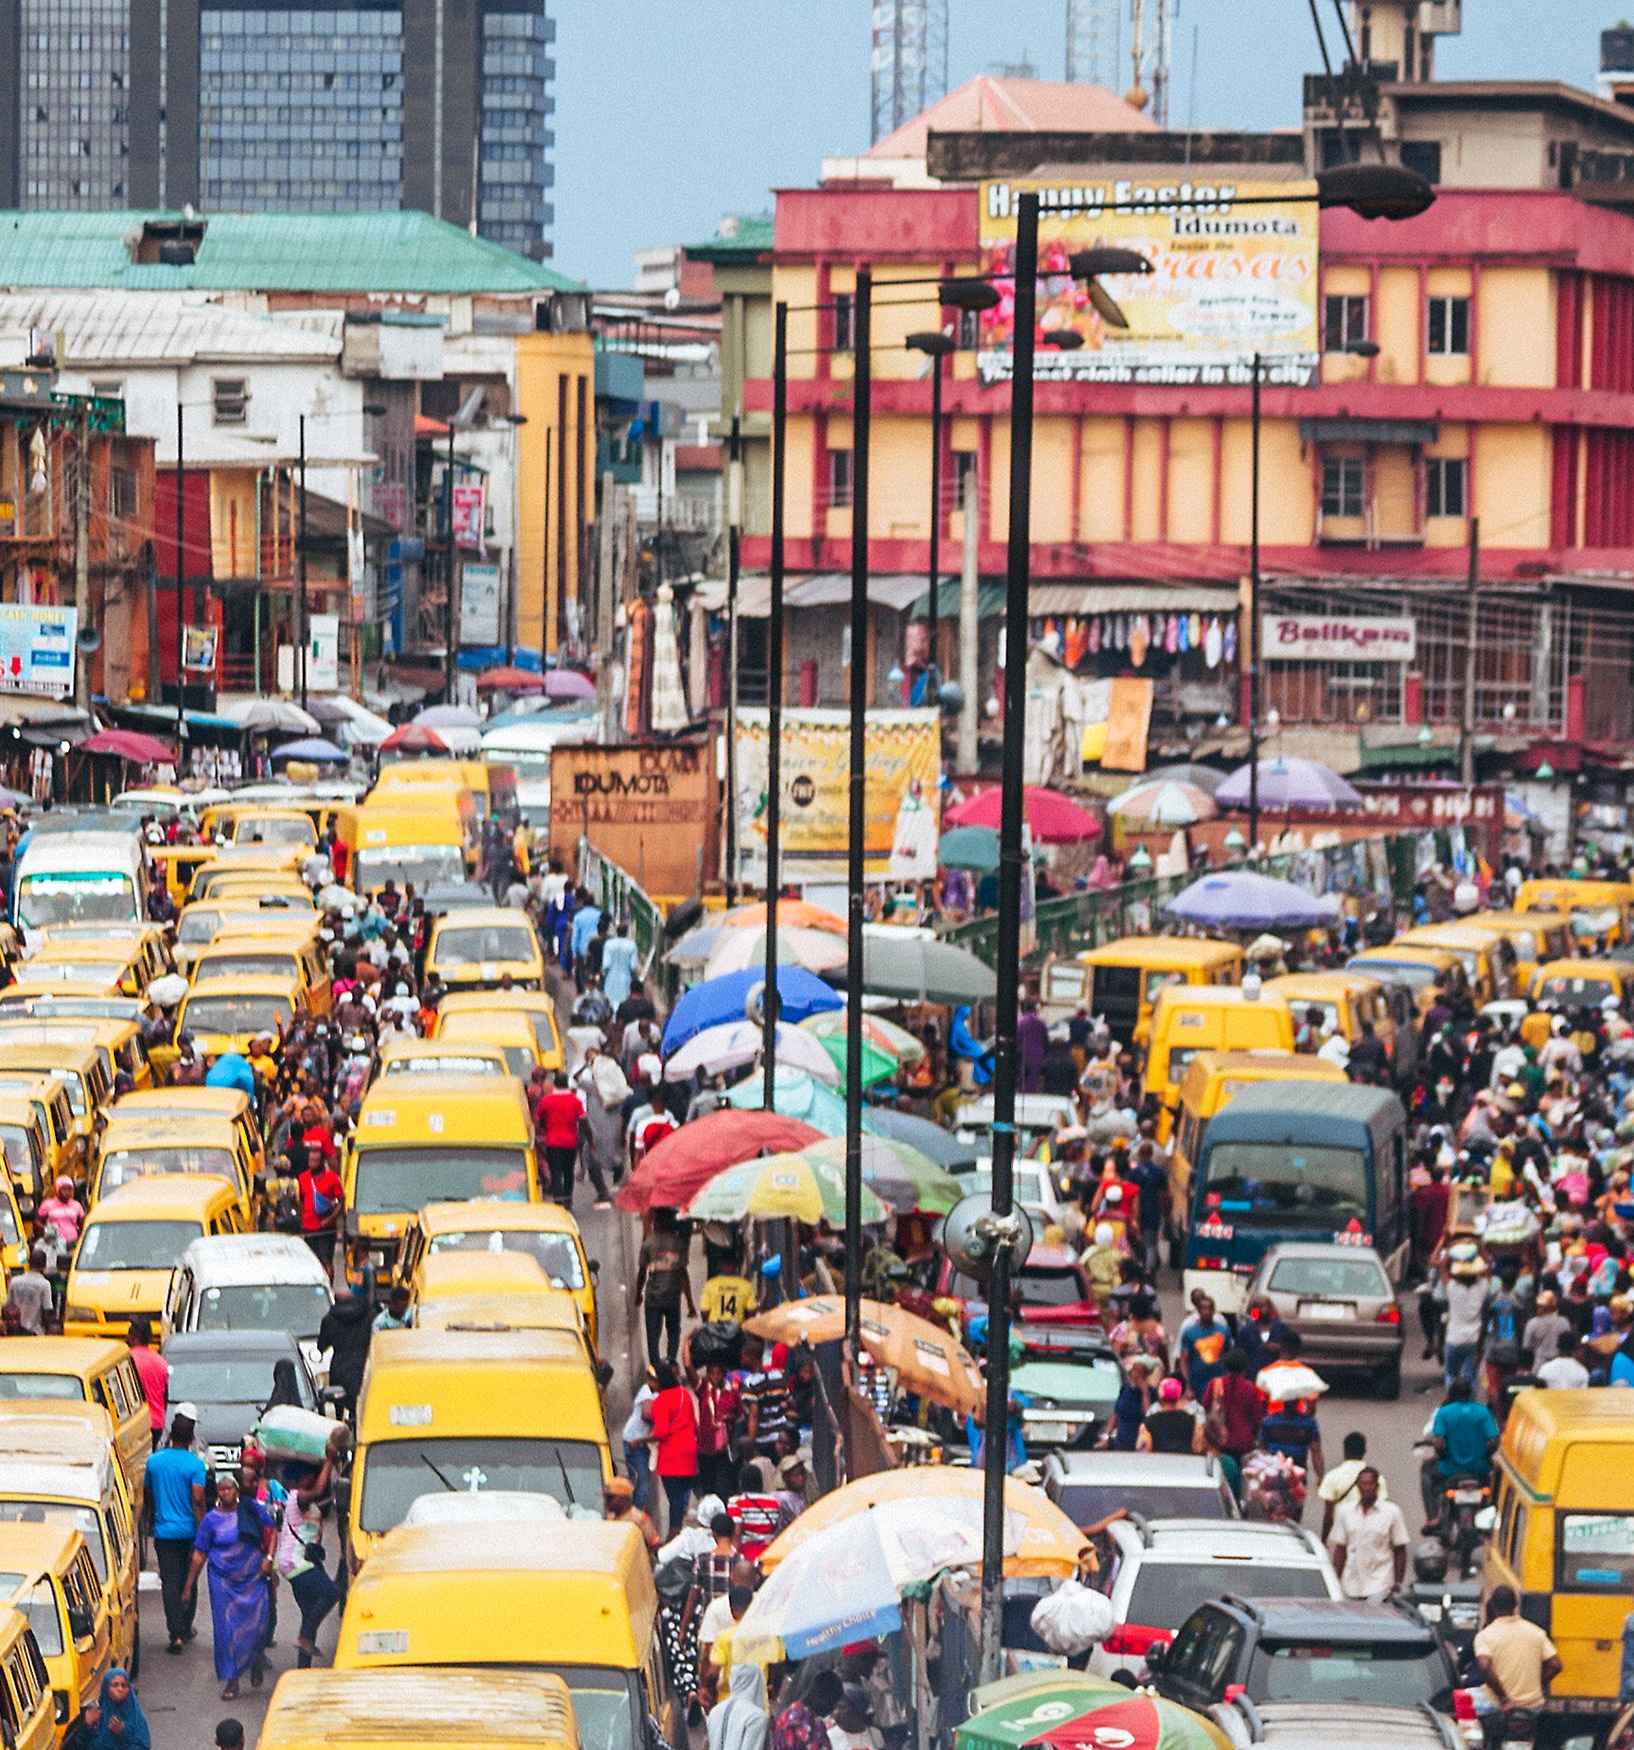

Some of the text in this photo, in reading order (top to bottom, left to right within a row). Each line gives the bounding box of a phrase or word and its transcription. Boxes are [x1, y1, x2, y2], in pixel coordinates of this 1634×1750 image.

[1114, 180, 1237, 216] Easter
[1172, 217, 1300, 236] Idumota
[719, 1295, 737, 1316] 14
[806, 1609, 877, 1648] Healthy Choice
